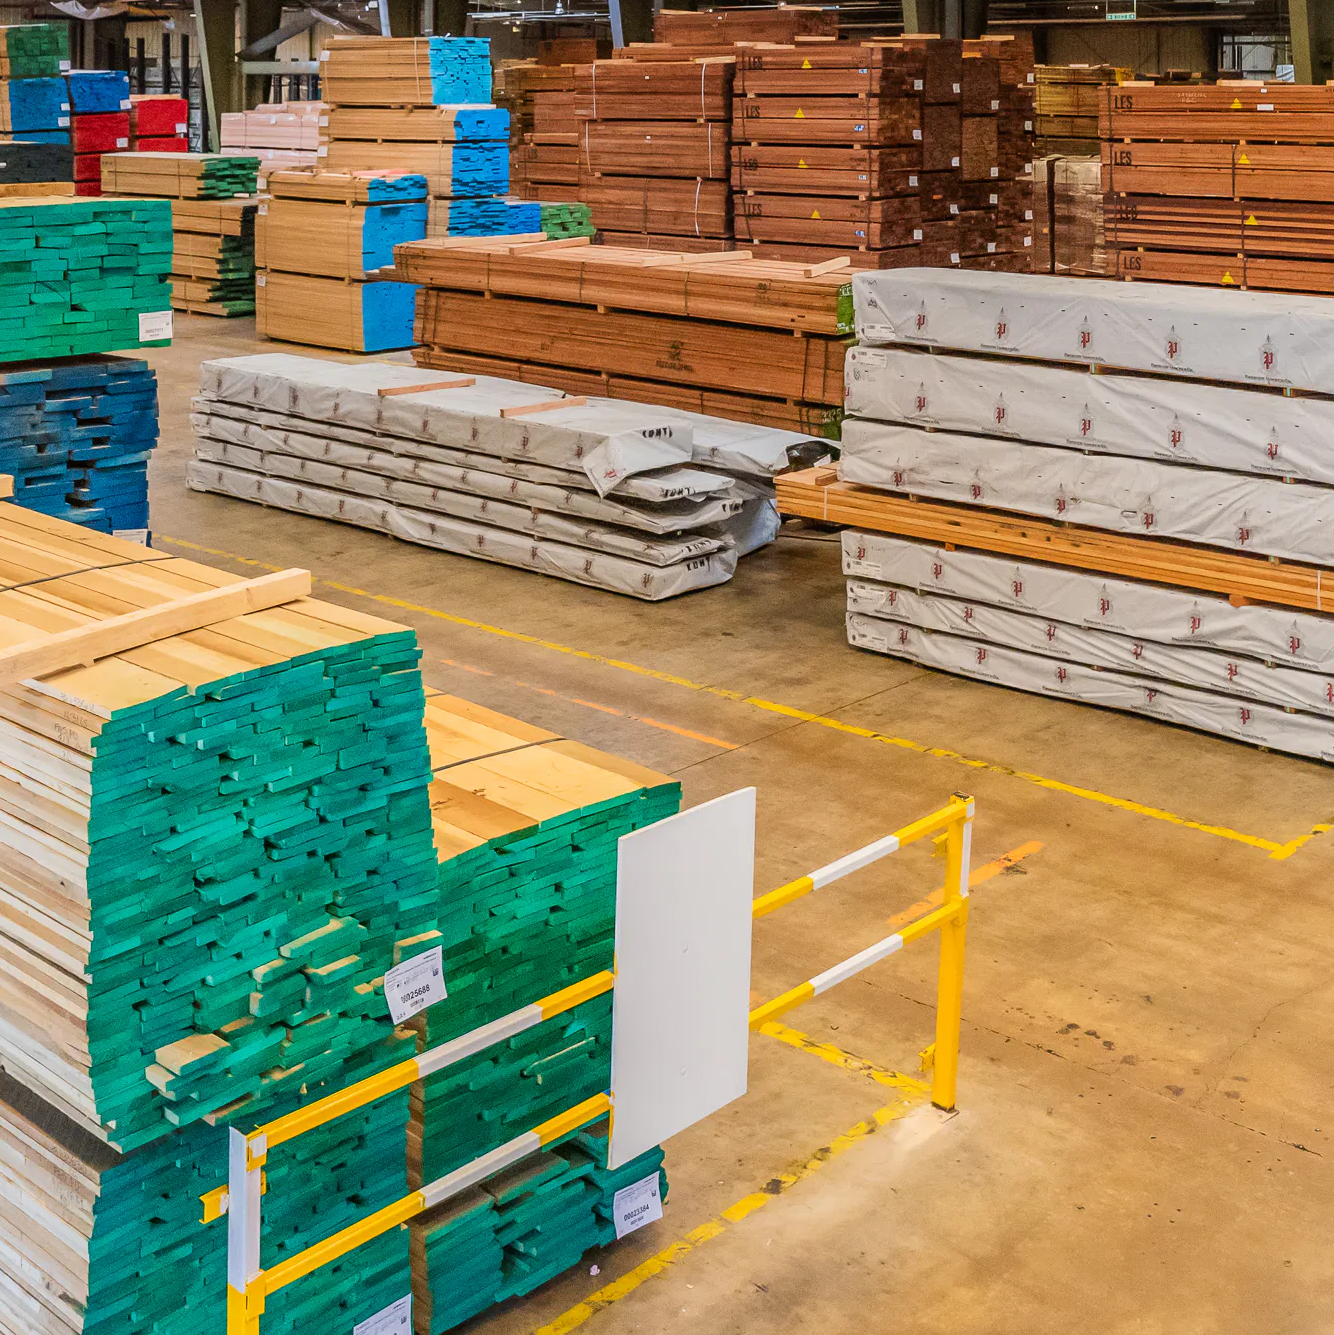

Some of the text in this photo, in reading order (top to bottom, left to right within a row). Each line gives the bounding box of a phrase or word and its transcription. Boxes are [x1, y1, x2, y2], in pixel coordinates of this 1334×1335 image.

[748, 56, 763, 69] LES
[1114, 95, 1133, 109] LES
[1114, 151, 1132, 165] LES
[748, 203, 762, 215] LES
[1123, 256, 1142, 270] LES
